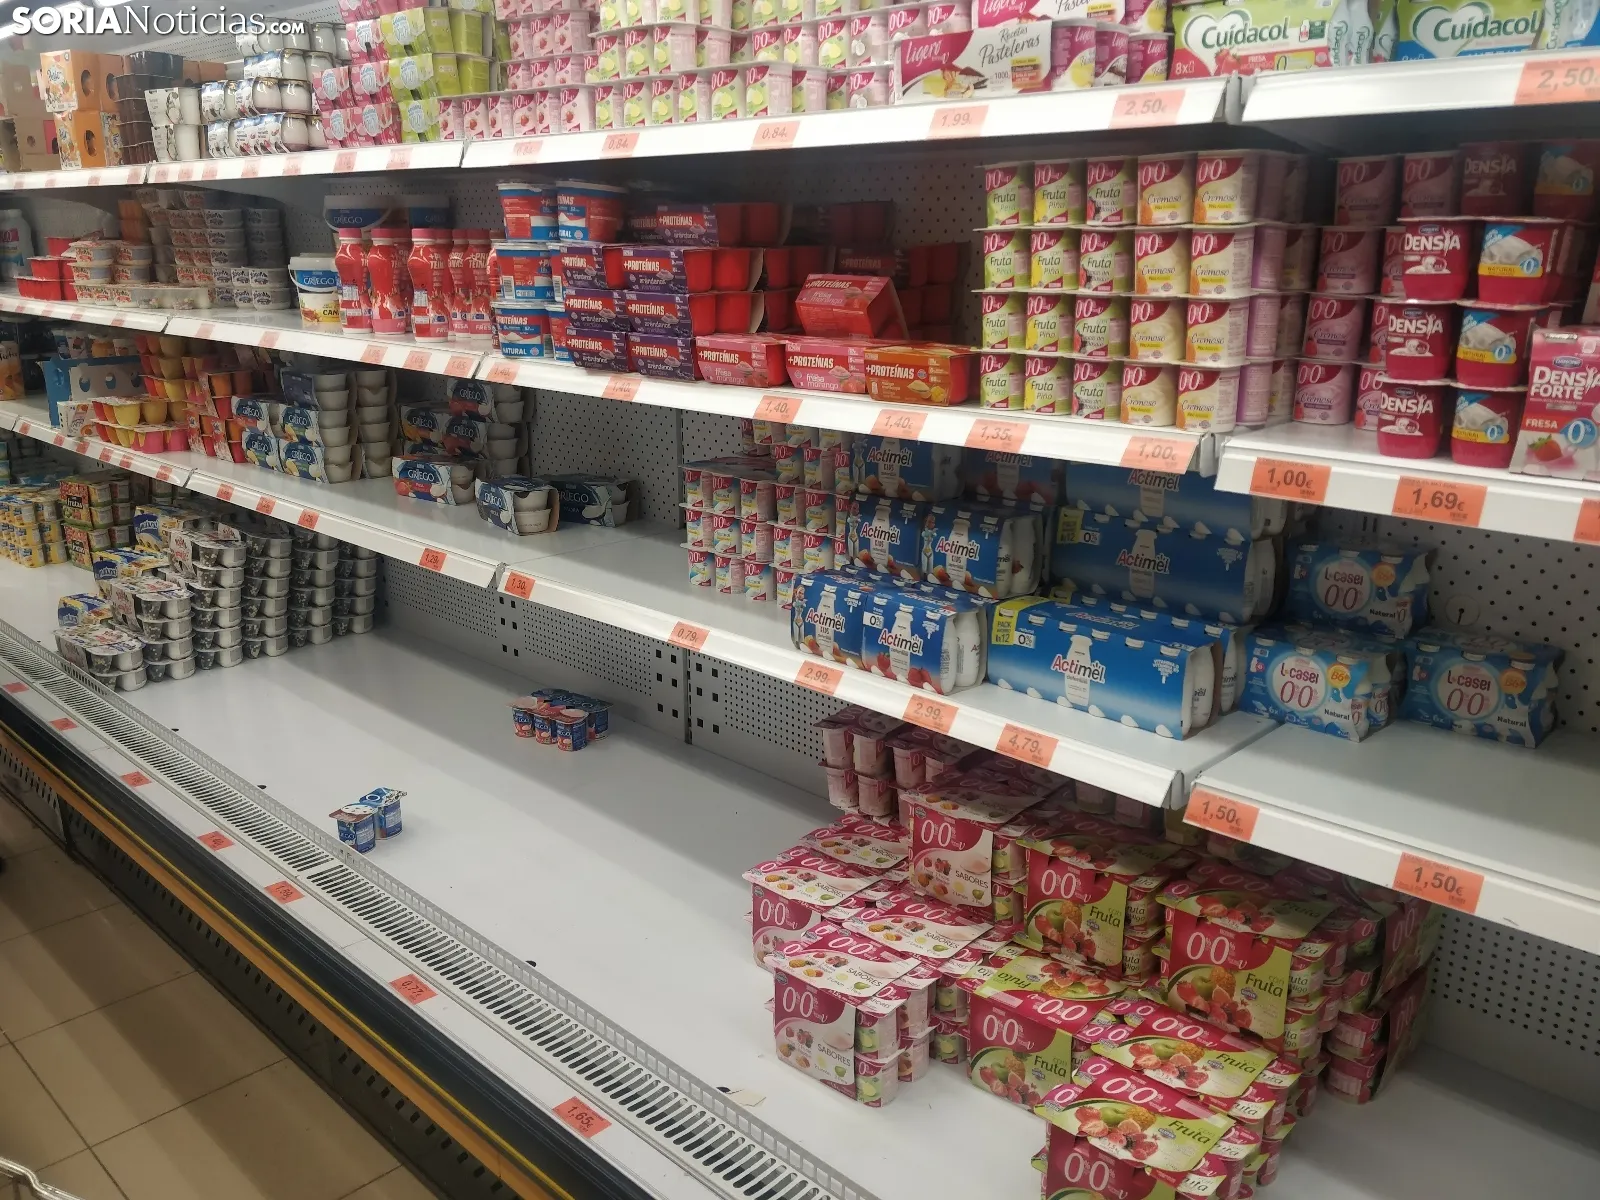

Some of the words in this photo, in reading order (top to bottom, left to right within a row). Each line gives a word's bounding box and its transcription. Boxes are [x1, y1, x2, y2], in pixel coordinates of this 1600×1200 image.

[906, 40, 942, 67] Ligero
[979, 34, 1041, 67] Pasteleras
[1530, 384, 1584, 400] FORTE
[1525, 418, 1558, 429] FRESA
[868, 447, 912, 467] Actimel
[1128, 468, 1180, 491] Actimel
[1412, 488, 1465, 511] 1,69€
[861, 522, 900, 544] Actimel
[936, 537, 979, 560] Actimel
[1117, 550, 1170, 574] Actimel
[807, 608, 845, 633] Actimel
[1369, 608, 1396, 619] Natural
[878, 629, 923, 655] Actimel
[1052, 655, 1106, 683] Actimel
[1324, 708, 1350, 721] Natural
[1497, 714, 1527, 727] Natural
[869, 846, 899, 861] SABORES
[814, 882, 846, 898] SABORES
[955, 870, 989, 889] SABORES
[1414, 866, 1464, 896] 1,50€
[1089, 905, 1121, 928] Fruta
[924, 931, 959, 949] SABORES
[846, 967, 882, 987] SABORES
[1245, 972, 1284, 998] Fruta
[817, 1044, 851, 1067] SABORES
[1033, 1055, 1067, 1078] Fruta
[1215, 1053, 1257, 1074] Fruta
[1168, 1119, 1211, 1144] Fruta
